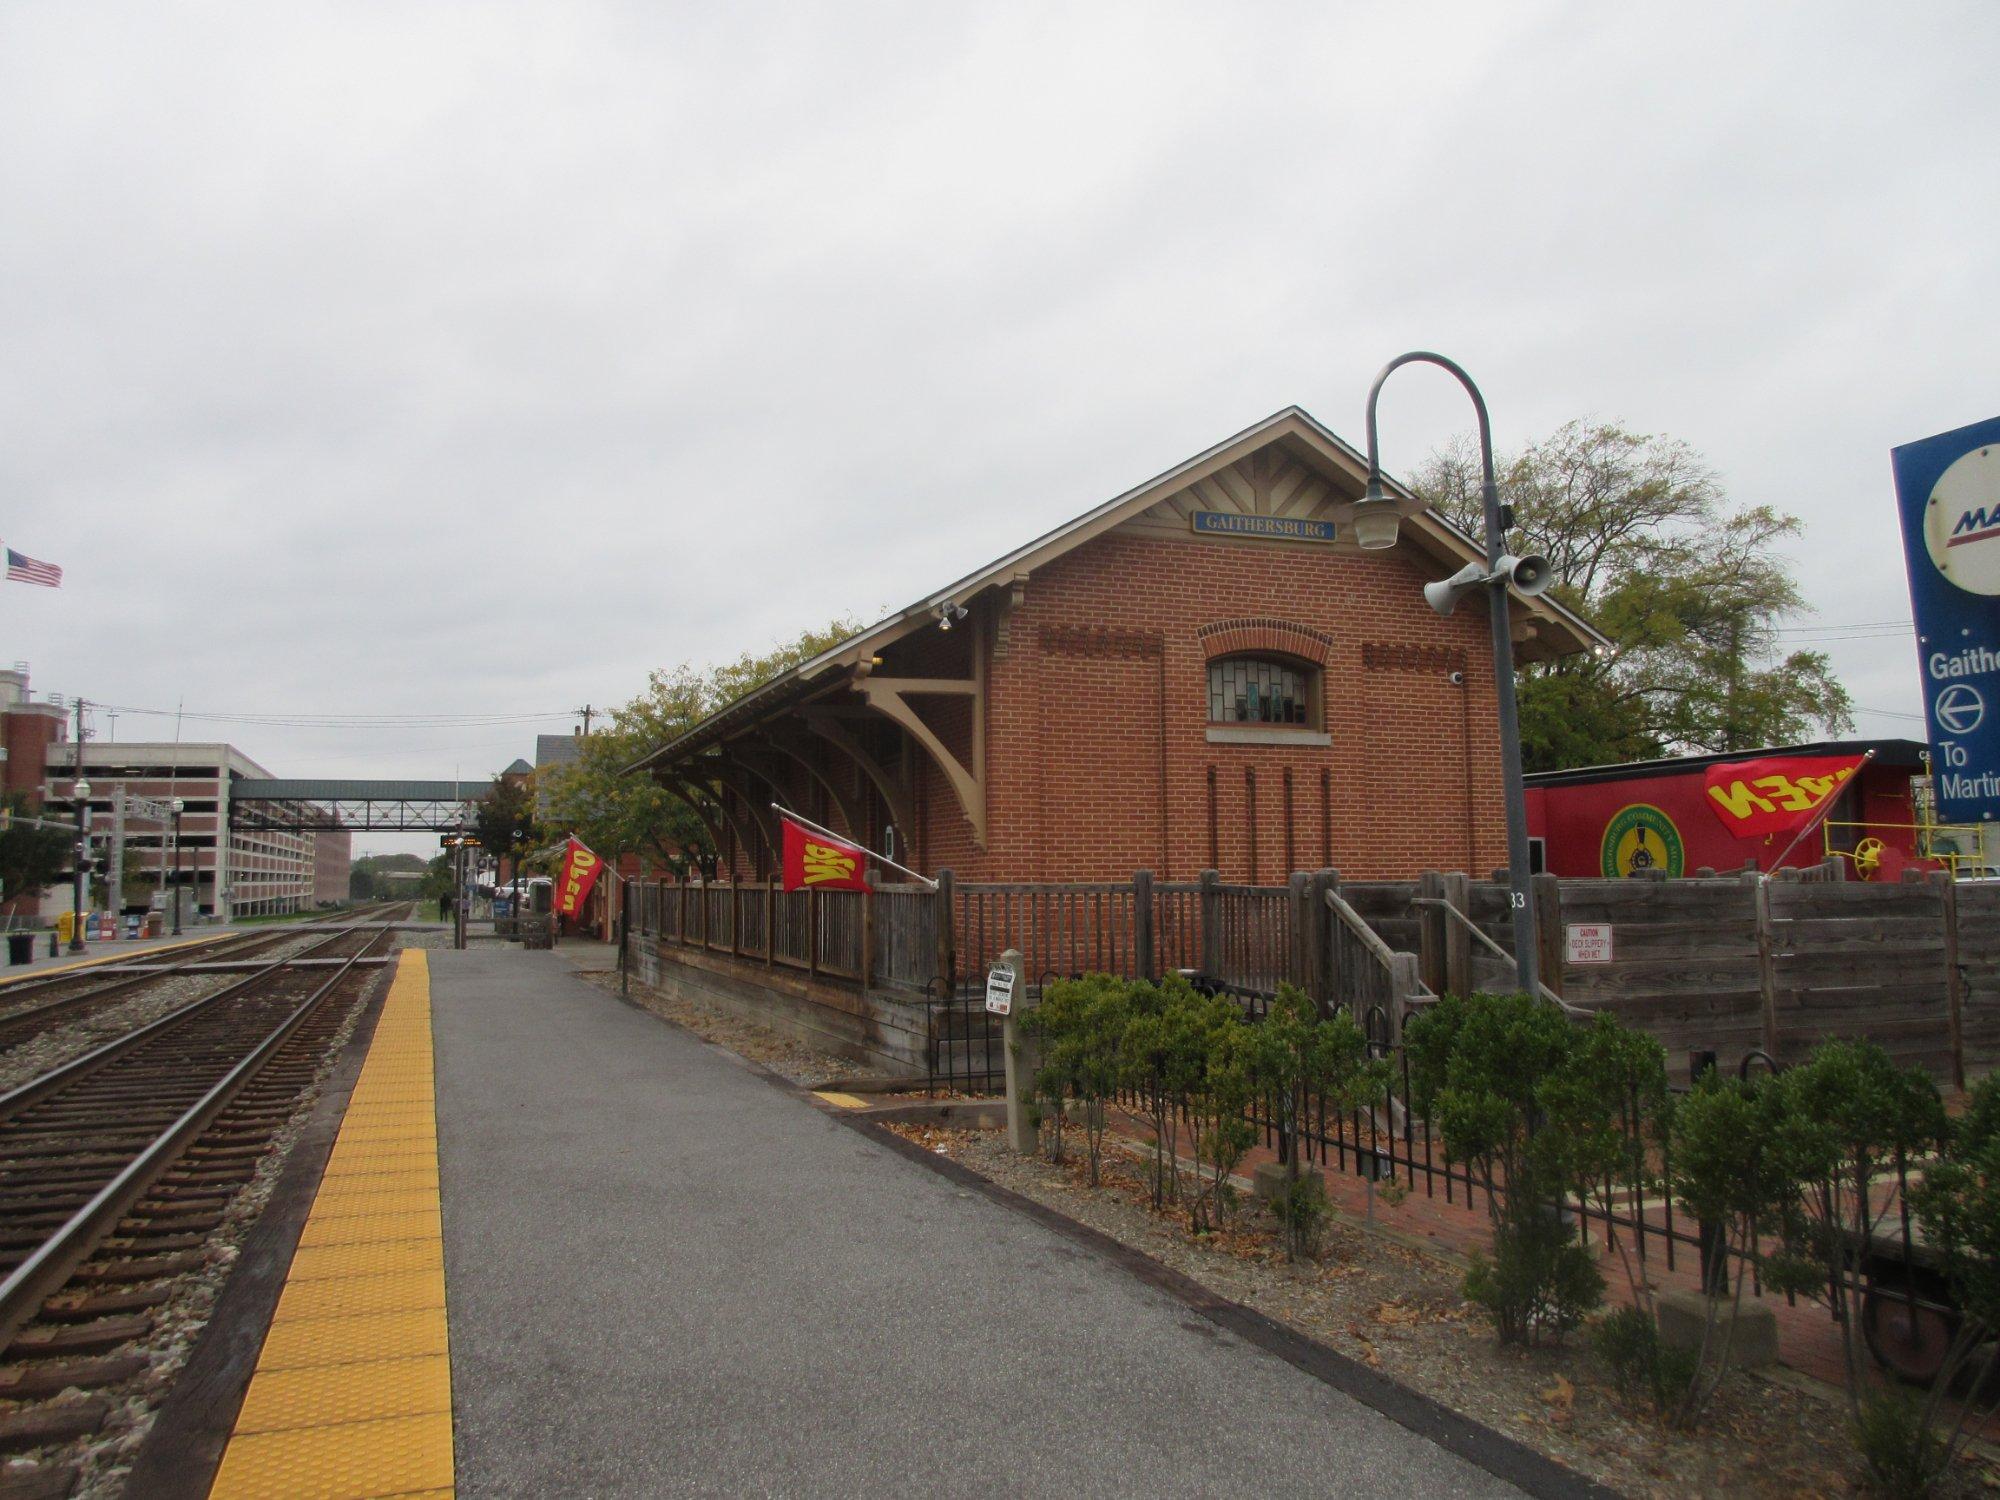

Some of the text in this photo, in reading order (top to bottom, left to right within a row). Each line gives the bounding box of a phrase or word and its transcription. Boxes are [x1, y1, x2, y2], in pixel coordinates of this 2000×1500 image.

[1206, 514, 1326, 537] GAITHERSBURG
[1938, 741, 1967, 767] To
[1941, 771, 2000, 800] Marti
[1571, 939, 1607, 949] DECK SLIPPERY
[1580, 928, 1599, 937] CAUTION
